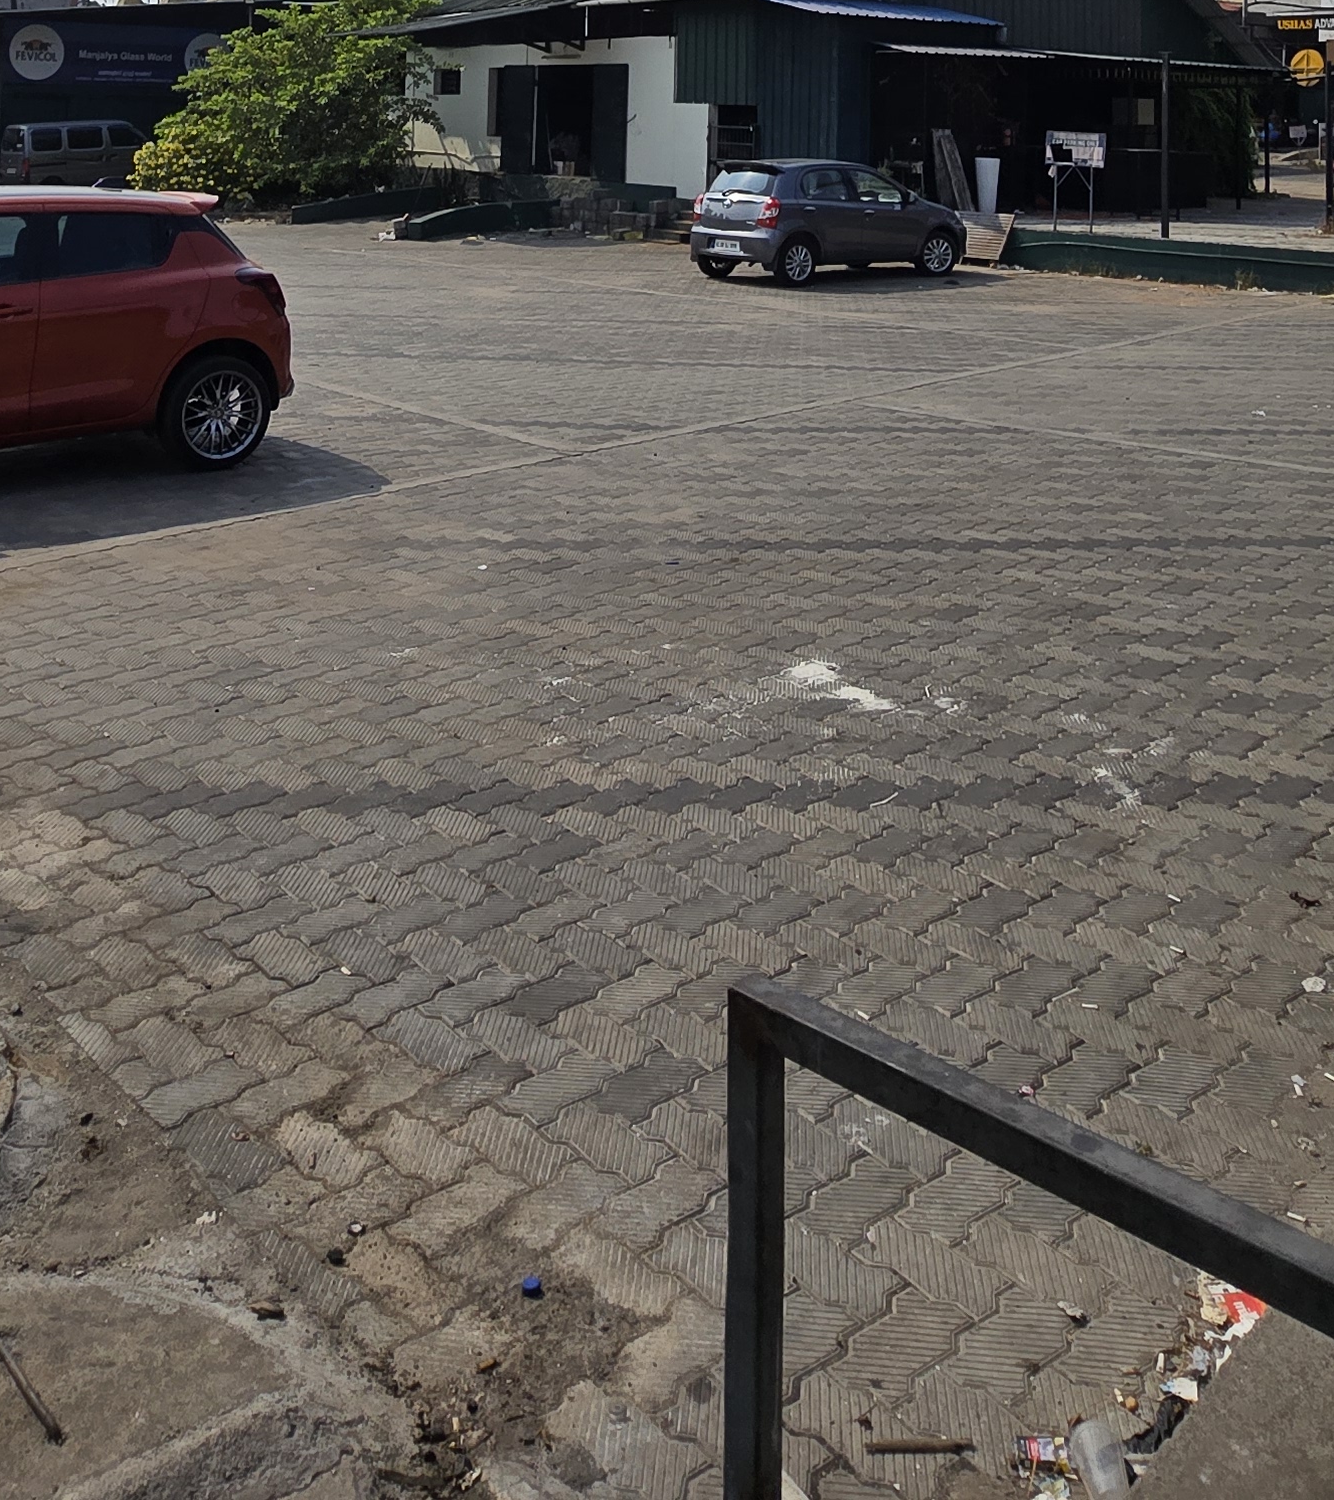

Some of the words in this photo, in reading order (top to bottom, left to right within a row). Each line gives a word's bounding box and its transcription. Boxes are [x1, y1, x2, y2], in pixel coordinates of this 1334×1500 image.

[1277, 19, 1313, 30] USHAS
[15, 50, 58, 63] FEVICOL
[120, 51, 145, 61] Glass
[147, 52, 173, 62] World
